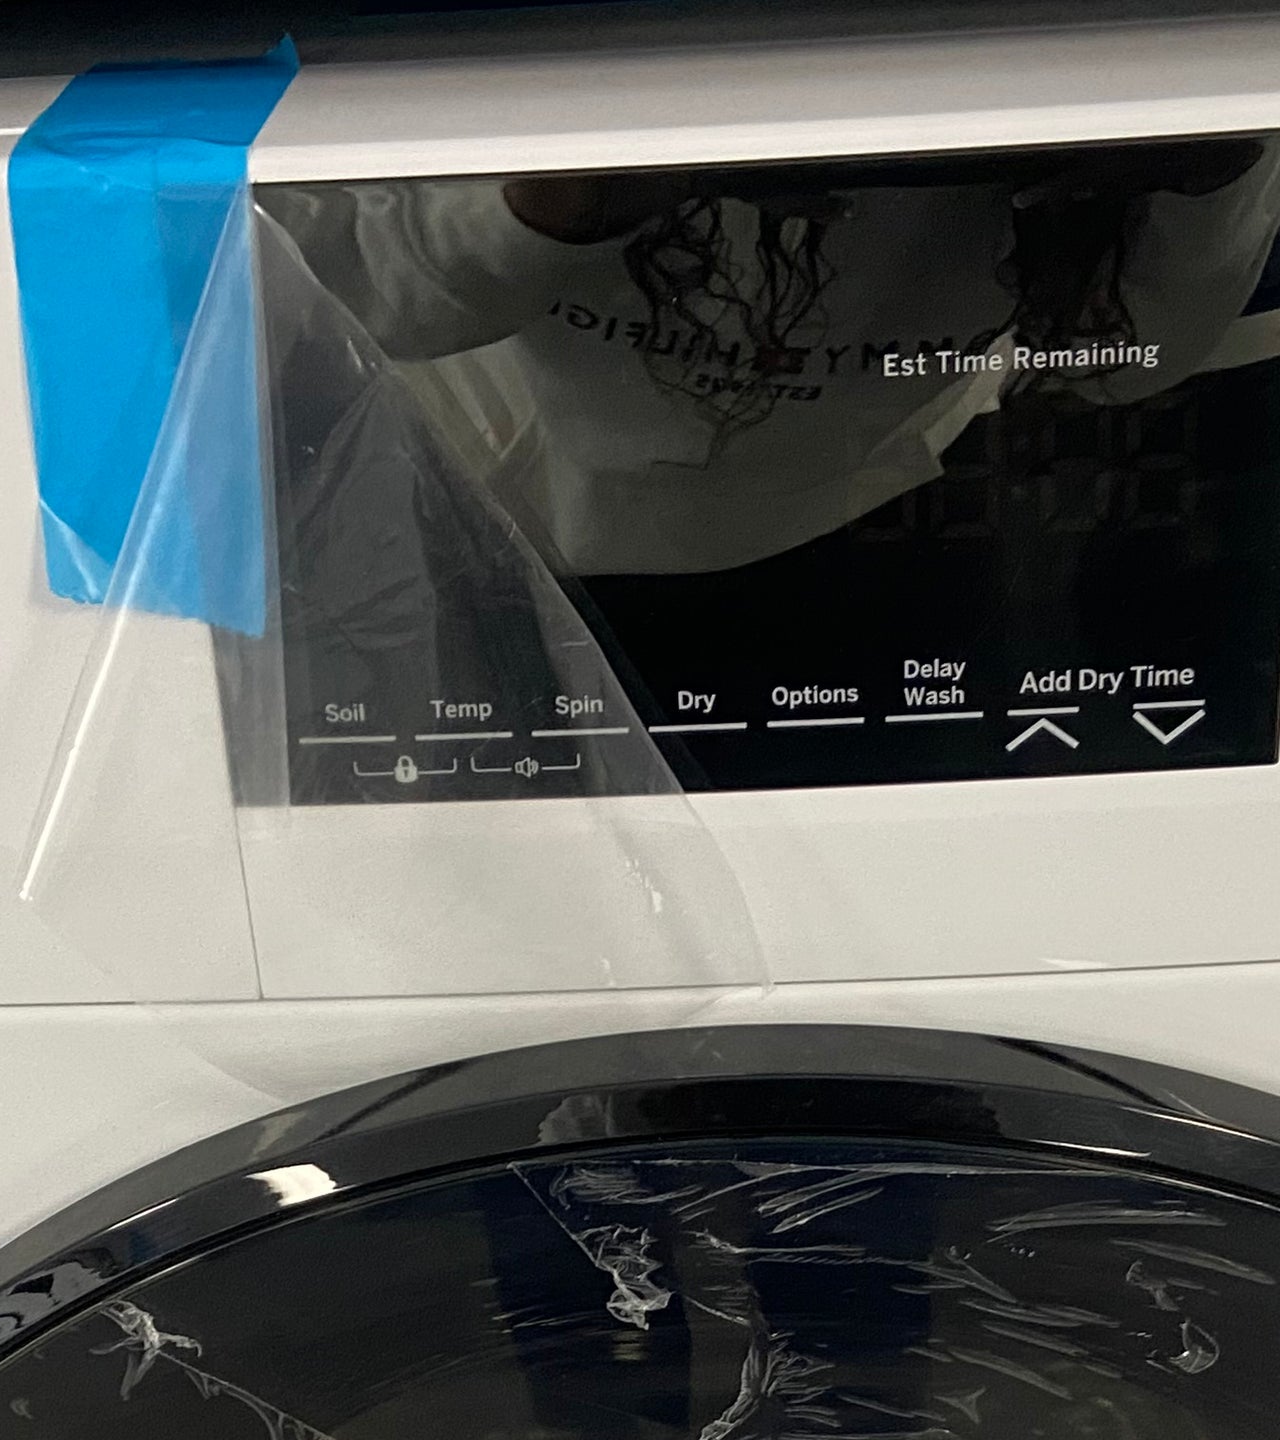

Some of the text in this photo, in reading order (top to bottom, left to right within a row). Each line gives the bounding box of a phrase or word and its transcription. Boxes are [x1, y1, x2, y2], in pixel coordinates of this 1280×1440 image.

[882, 341, 1160, 377] Est Time Remaining
[903, 658, 966, 681] Delay
[1020, 664, 1195, 694] Add Dry Time
[554, 694, 604, 717] Spin
[677, 690, 717, 713] Dry
[771, 685, 860, 709] Options
[904, 684, 965, 706] Wash
[325, 704, 366, 723] Soil
[429, 700, 493, 721] Temp
